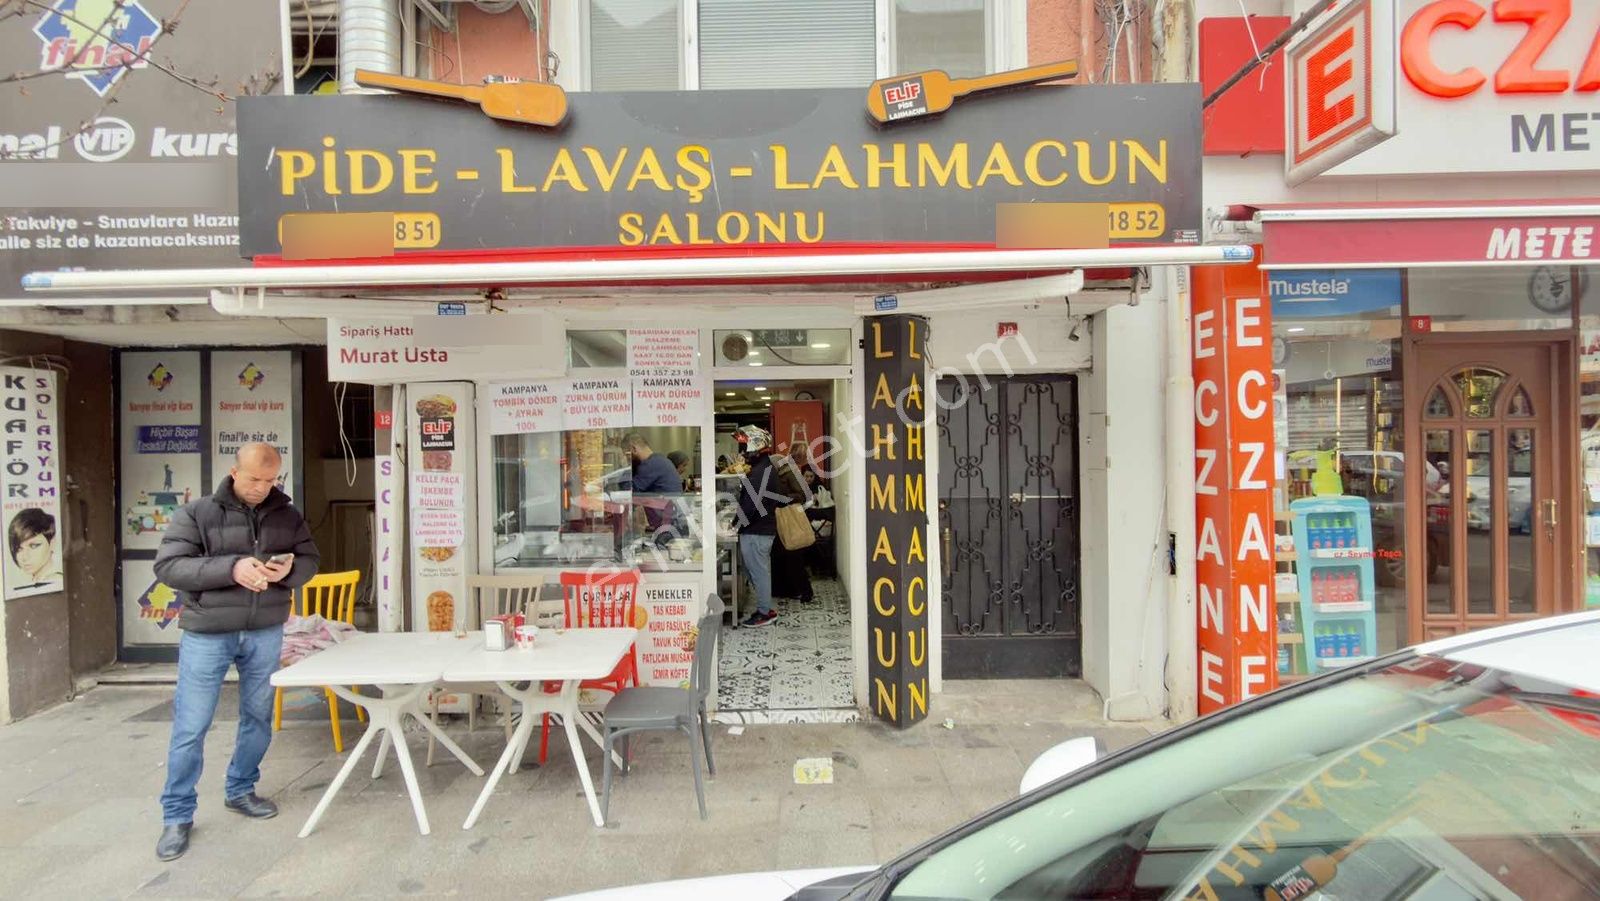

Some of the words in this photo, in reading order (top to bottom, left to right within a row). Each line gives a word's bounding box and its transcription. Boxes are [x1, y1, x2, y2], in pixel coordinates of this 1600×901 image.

[47, 36, 152, 68] final
[1401, 0, 1600, 98] CZ
[1306, 26, 1354, 142] E
[885, 81, 920, 104] ELİF
[81, 128, 128, 151] VIP
[276, 136, 439, 196] PİDE
[497, 144, 712, 201] LAVAŞ
[769, 139, 1167, 190] LAHMACUN
[9, 216, 78, 232] Takviye
[98, 214, 189, 229] Sınavlara
[1136, 210, 1159, 230] 52
[413, 220, 434, 240] 51
[619, 211, 824, 246] SALONU
[36, 235, 61, 249] siz
[66, 235, 90, 248] de
[95, 233, 240, 248] kazanacaksınız
[1486, 226, 1593, 259] METE
[340, 326, 380, 338] Sipariş
[384, 326, 414, 336] Hattı
[1417, 320, 1425, 329] 8
[340, 348, 399, 363] Murat
[404, 347, 449, 363] Usta
[501, 385, 548, 395] KAMPANYA
[573, 380, 619, 390] KAMPANYA
[643, 378, 692, 387] KAMPANYA
[565, 394, 593, 403] ZURNA
[636, 390, 666, 398] TAVUK
[269, 401, 284, 410] kurs
[602, 404, 631, 413] AYRAN
[656, 402, 686, 410] AYRAN
[380, 415, 391, 424] 12
[515, 409, 544, 418] AYRAN
[423, 419, 452, 434] ELİF
[5, 374, 29, 498] KUAFÖR
[36, 378, 55, 497] SOLARYUM
[252, 431, 264, 442] siz
[267, 431, 278, 441] de
[1195, 309, 1224, 704] ECZANE
[1235, 298, 1270, 702] ECZANE
[871, 322, 897, 721] LAHMACUN
[905, 320, 928, 719] LAHMACUN
[646, 589, 693, 600] YEMEKLER
[653, 606, 664, 615] TAS
[665, 606, 686, 615] KEBABI
[649, 621, 664, 632] KURU
[653, 637, 671, 647] TAVUK
[642, 653, 669, 663] PATLICAN
